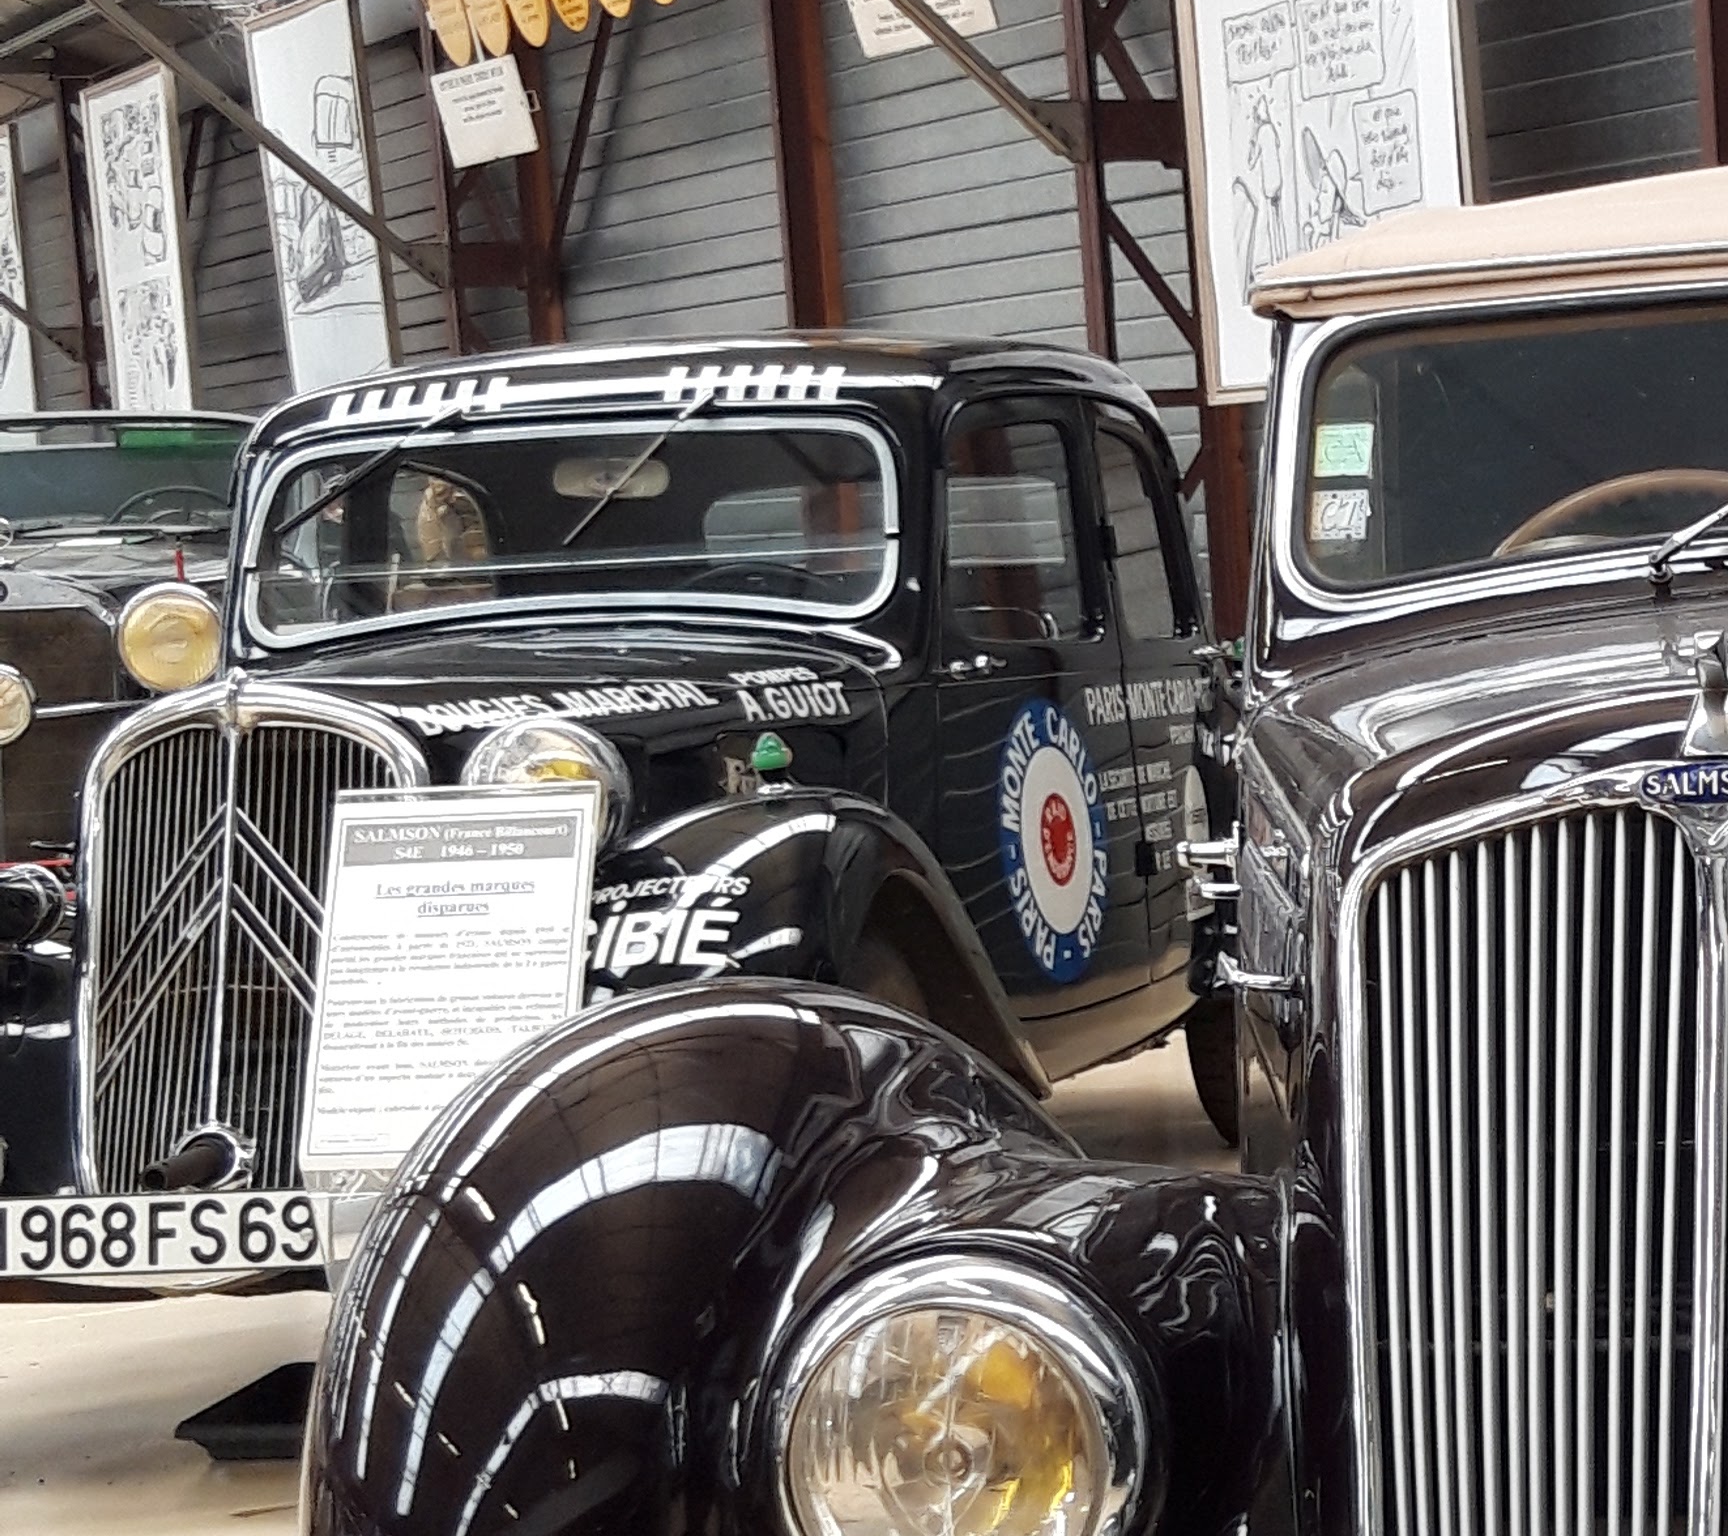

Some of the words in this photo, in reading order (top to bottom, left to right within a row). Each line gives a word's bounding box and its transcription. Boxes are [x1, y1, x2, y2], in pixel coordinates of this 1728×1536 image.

[728, 666, 819, 686] POMPES
[552, 680, 719, 716] MARCHAL
[737, 681, 851, 722] A.GUIOT
[1002, 710, 1042, 834] MONTE
[1045, 706, 1098, 807] CARLO
[353, 827, 440, 844] SALMSON
[376, 882, 401, 897] Les
[405, 880, 465, 899] grandes
[470, 878, 535, 898] marques
[592, 875, 751, 905] PROJECTRS
[417, 900, 489, 918] disparues
